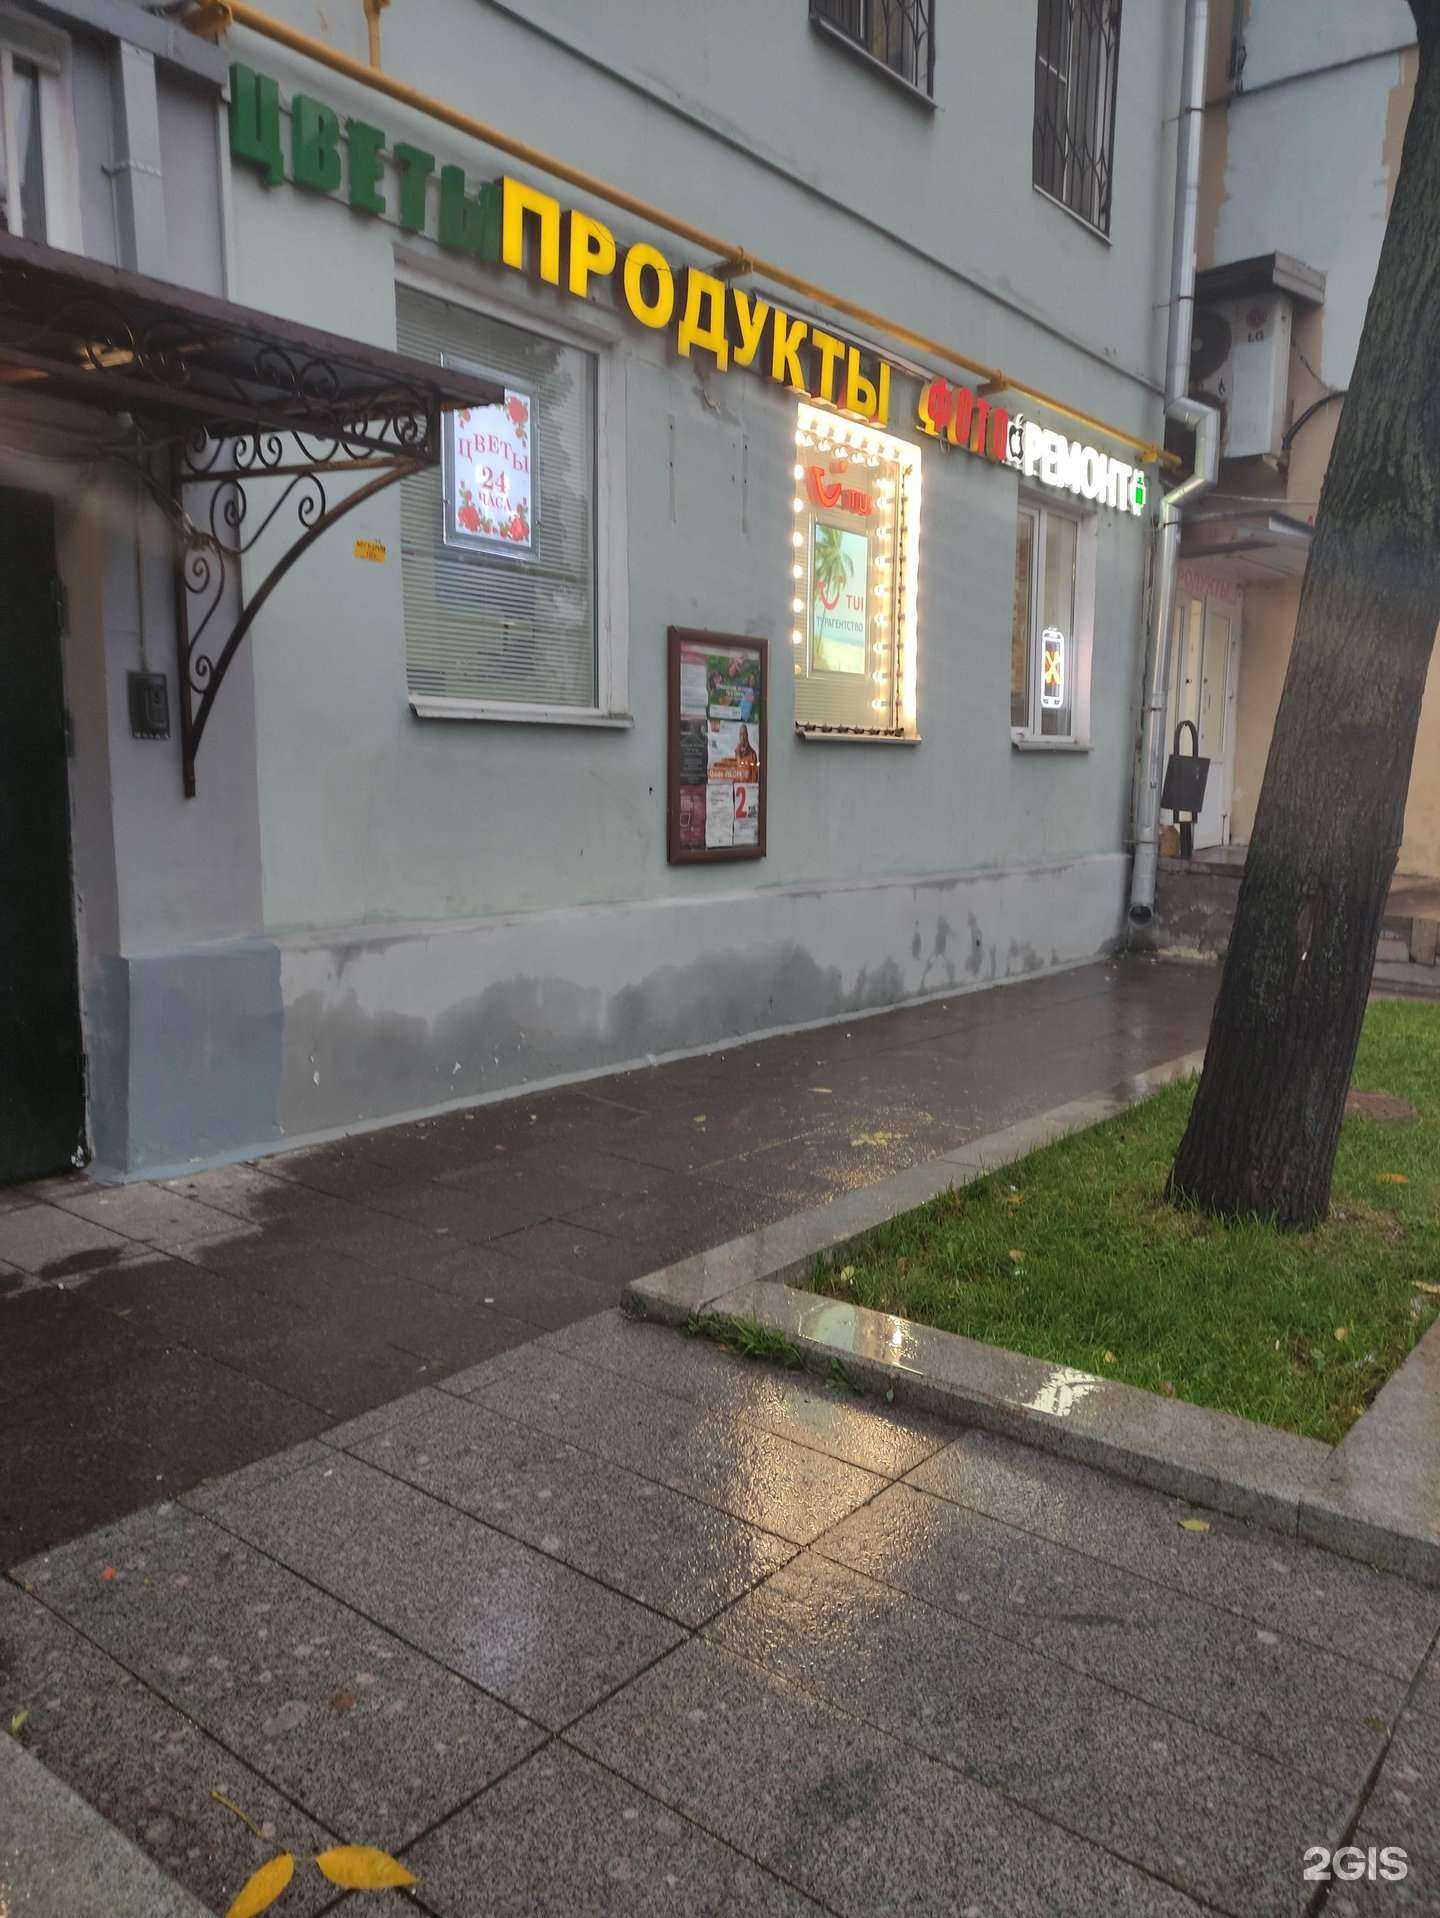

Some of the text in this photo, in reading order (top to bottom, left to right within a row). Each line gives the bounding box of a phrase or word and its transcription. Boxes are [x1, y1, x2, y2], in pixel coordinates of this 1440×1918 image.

[229, 62, 502, 264] ЦВЕТЫ
[502, 175, 891, 428] ПРОДУКТЫ
[458, 433, 529, 473] ЦВЕТЫ
[1022, 420, 1132, 513] РЕМОНТ
[481, 467, 507, 494] 24
[478, 491, 512, 511] ЧАСА
[846, 594, 864, 612] TUI
[816, 616, 864, 632] ТУРАГЕНТСТВО
[735, 786, 747, 819] 2
